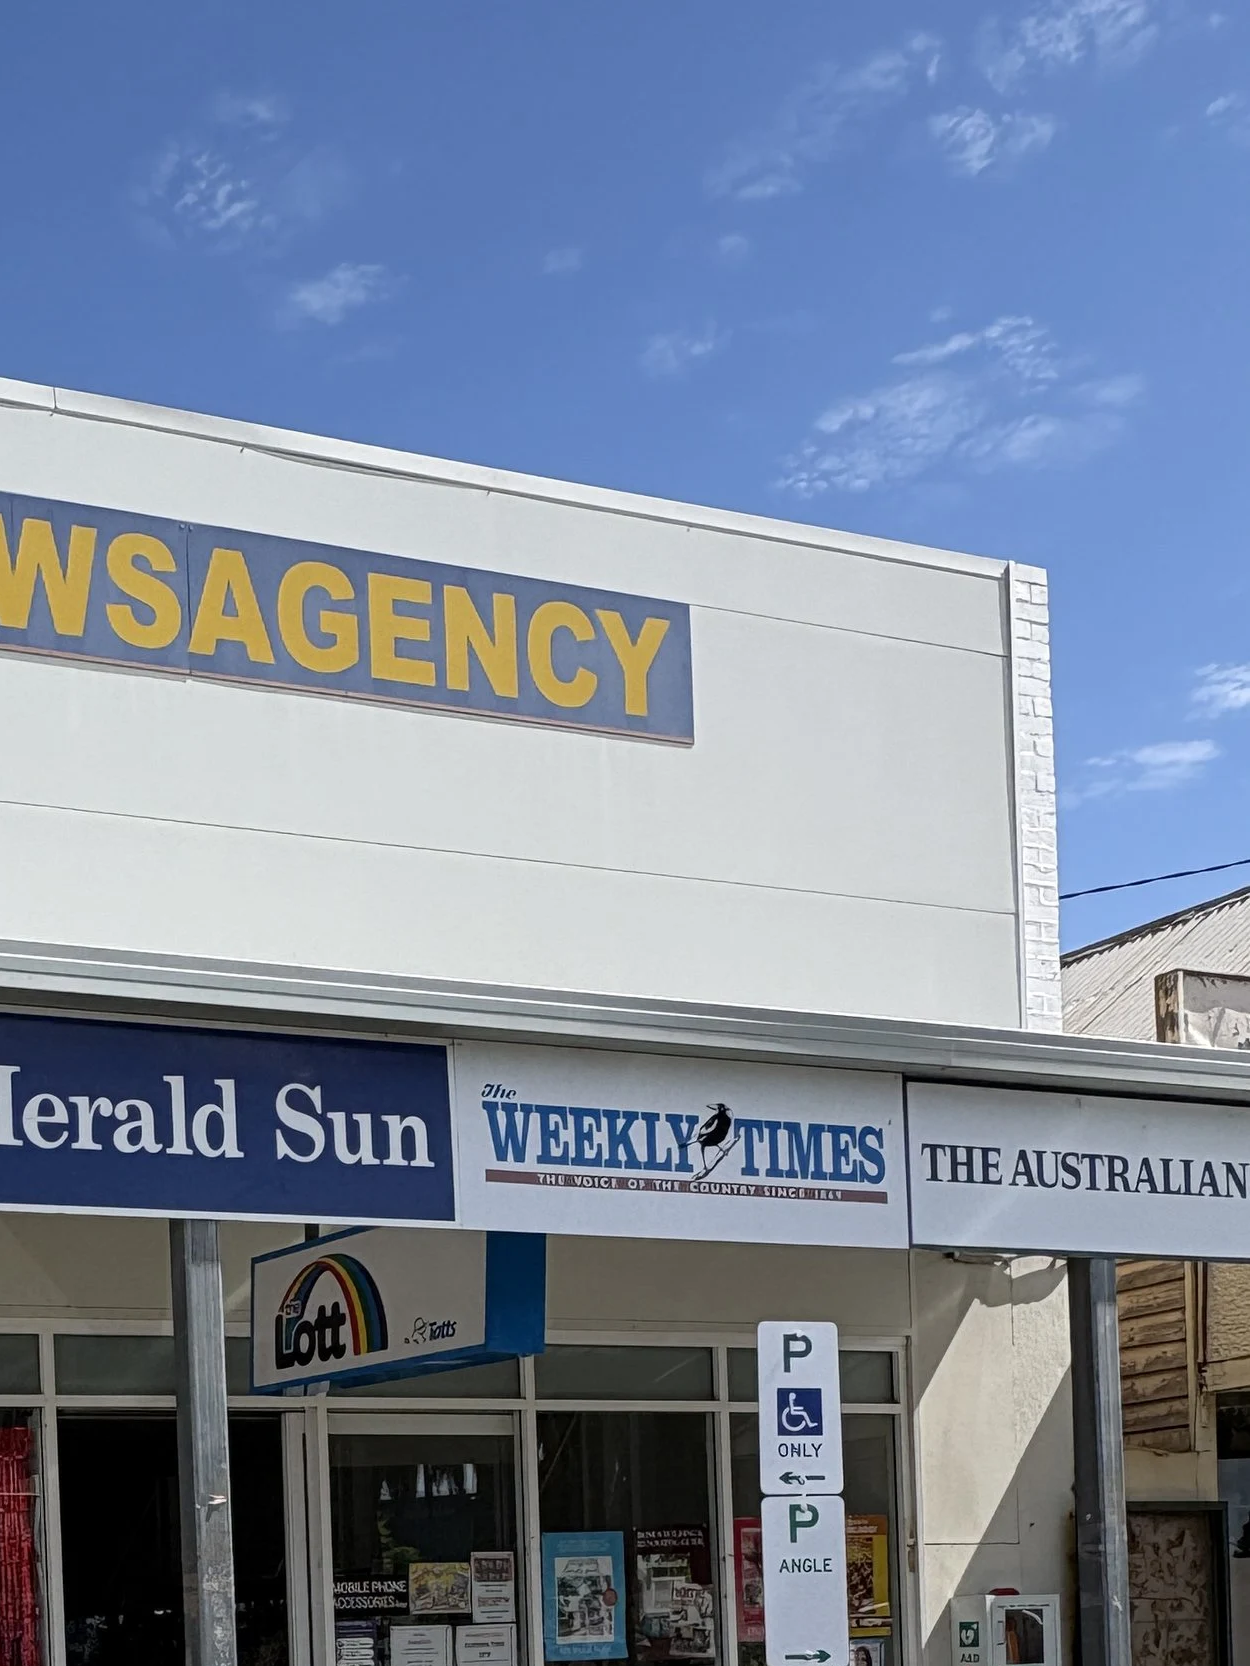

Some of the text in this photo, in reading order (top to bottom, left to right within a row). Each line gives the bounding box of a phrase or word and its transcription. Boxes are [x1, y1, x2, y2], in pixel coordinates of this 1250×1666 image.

[481, 1083, 517, 1101] The
[275, 1083, 435, 1168] Sun
[482, 1101, 886, 1184] WEEKLY TIMES
[628, 1179, 646, 1190] OF
[690, 1181, 756, 1196] COUNTRY
[921, 1142, 1250, 1199] THE AUSTRALIAN
[275, 1301, 347, 1369] Lott
[429, 1319, 457, 1341] Tatts
[783, 1334, 812, 1373] P
[778, 1443, 823, 1458] ONLY
[789, 1503, 819, 1543] P
[779, 1558, 832, 1573] ANGLE
